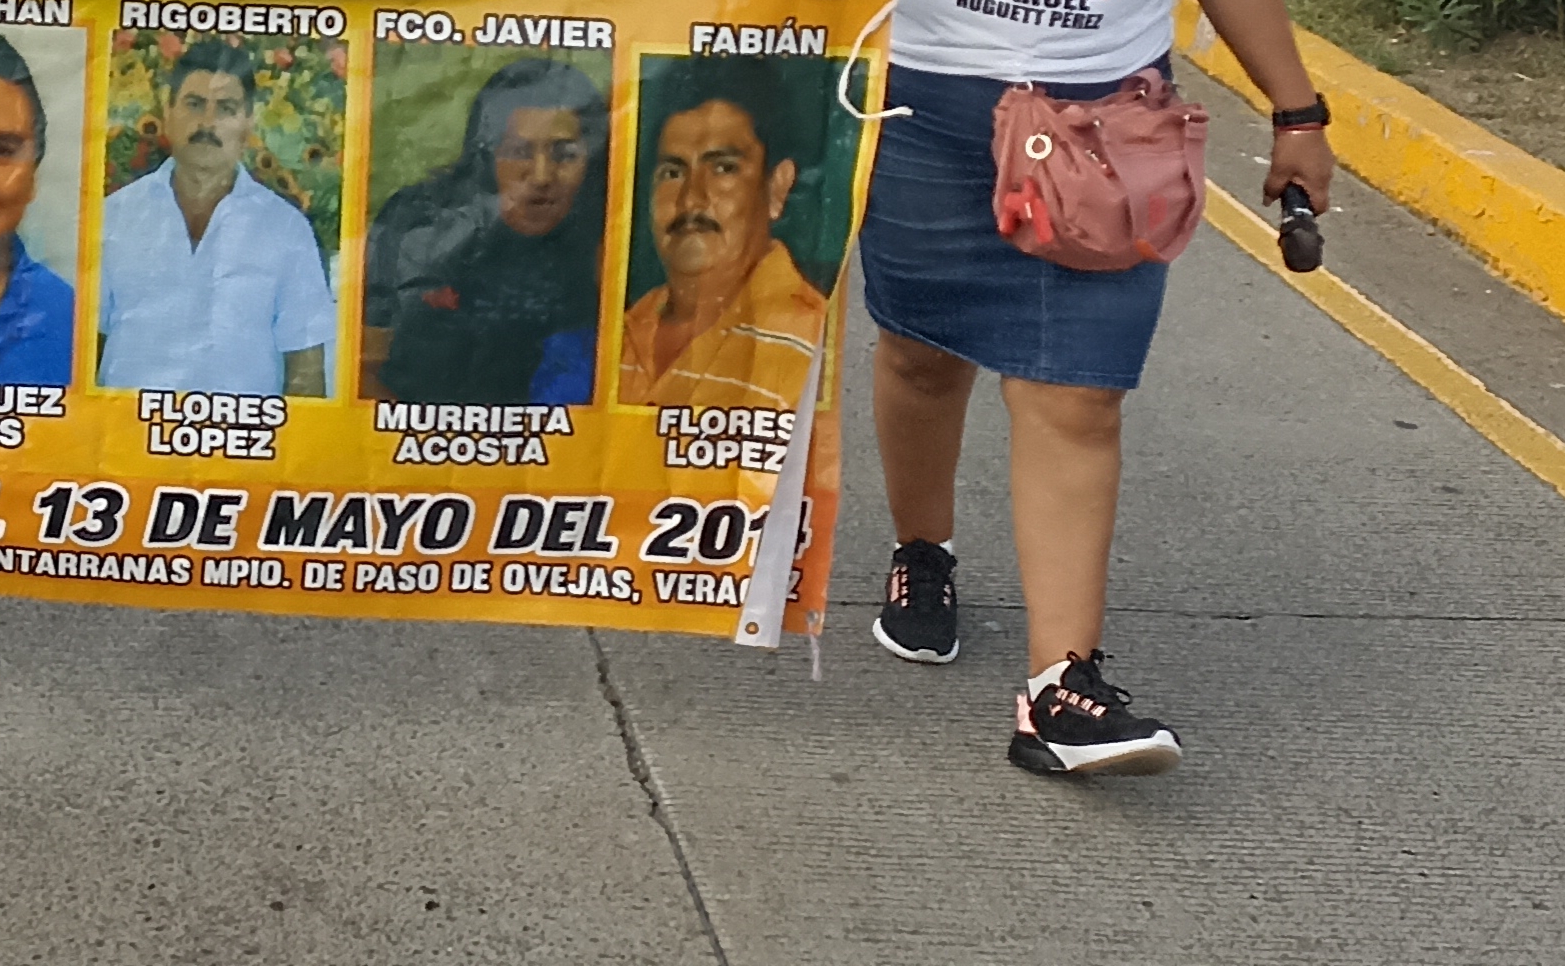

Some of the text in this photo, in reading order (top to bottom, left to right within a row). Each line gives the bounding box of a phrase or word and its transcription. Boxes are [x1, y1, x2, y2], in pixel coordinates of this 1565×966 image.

[120, 0, 347, 36] RIGOBERTO
[375, 8, 614, 50] FCO. JAVIER
[1048, 10, 1105, 31] PEREZ
[691, 18, 828, 58] FABIÁN
[140, 390, 287, 427] FLORES
[376, 402, 573, 434] MURRIETA
[657, 407, 796, 442] FLORES
[149, 414, 275, 460] LÓPEZ
[396, 434, 547, 466] ACOSTA
[665, 426, 788, 472] LÓPEZ
[33, 481, 127, 546] 13
[144, 486, 248, 550] DE
[261, 487, 476, 558] MAYO
[490, 494, 619, 559] DEL
[203, 559, 292, 591] MPIO.
[304, 561, 342, 593] DE
[355, 562, 440, 595] PASO
[452, 562, 492, 594] DE
[501, 563, 642, 604] OVEJAS,
